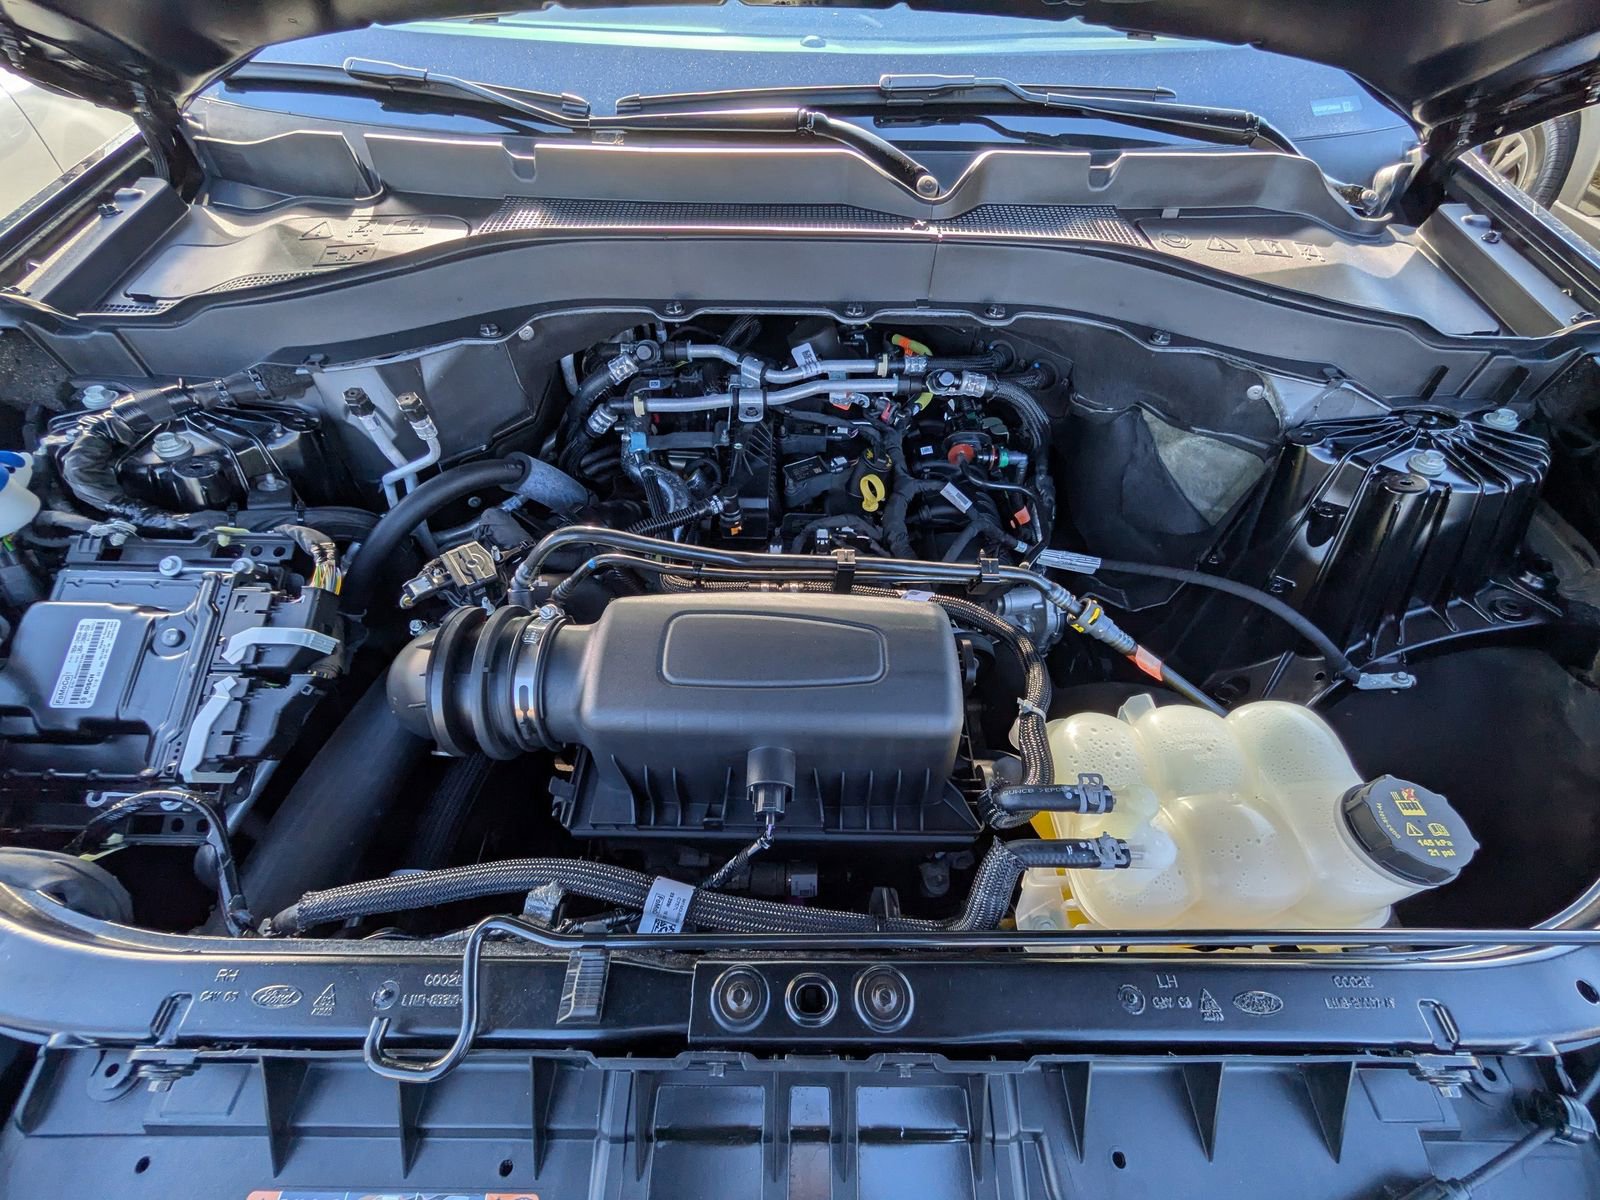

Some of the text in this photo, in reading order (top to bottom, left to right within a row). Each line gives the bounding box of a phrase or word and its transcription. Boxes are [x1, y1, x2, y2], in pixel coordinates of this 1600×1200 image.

[214, 968, 240, 982] RH
[1156, 974, 1179, 989] LH
[257, 988, 298, 1006] Ford
